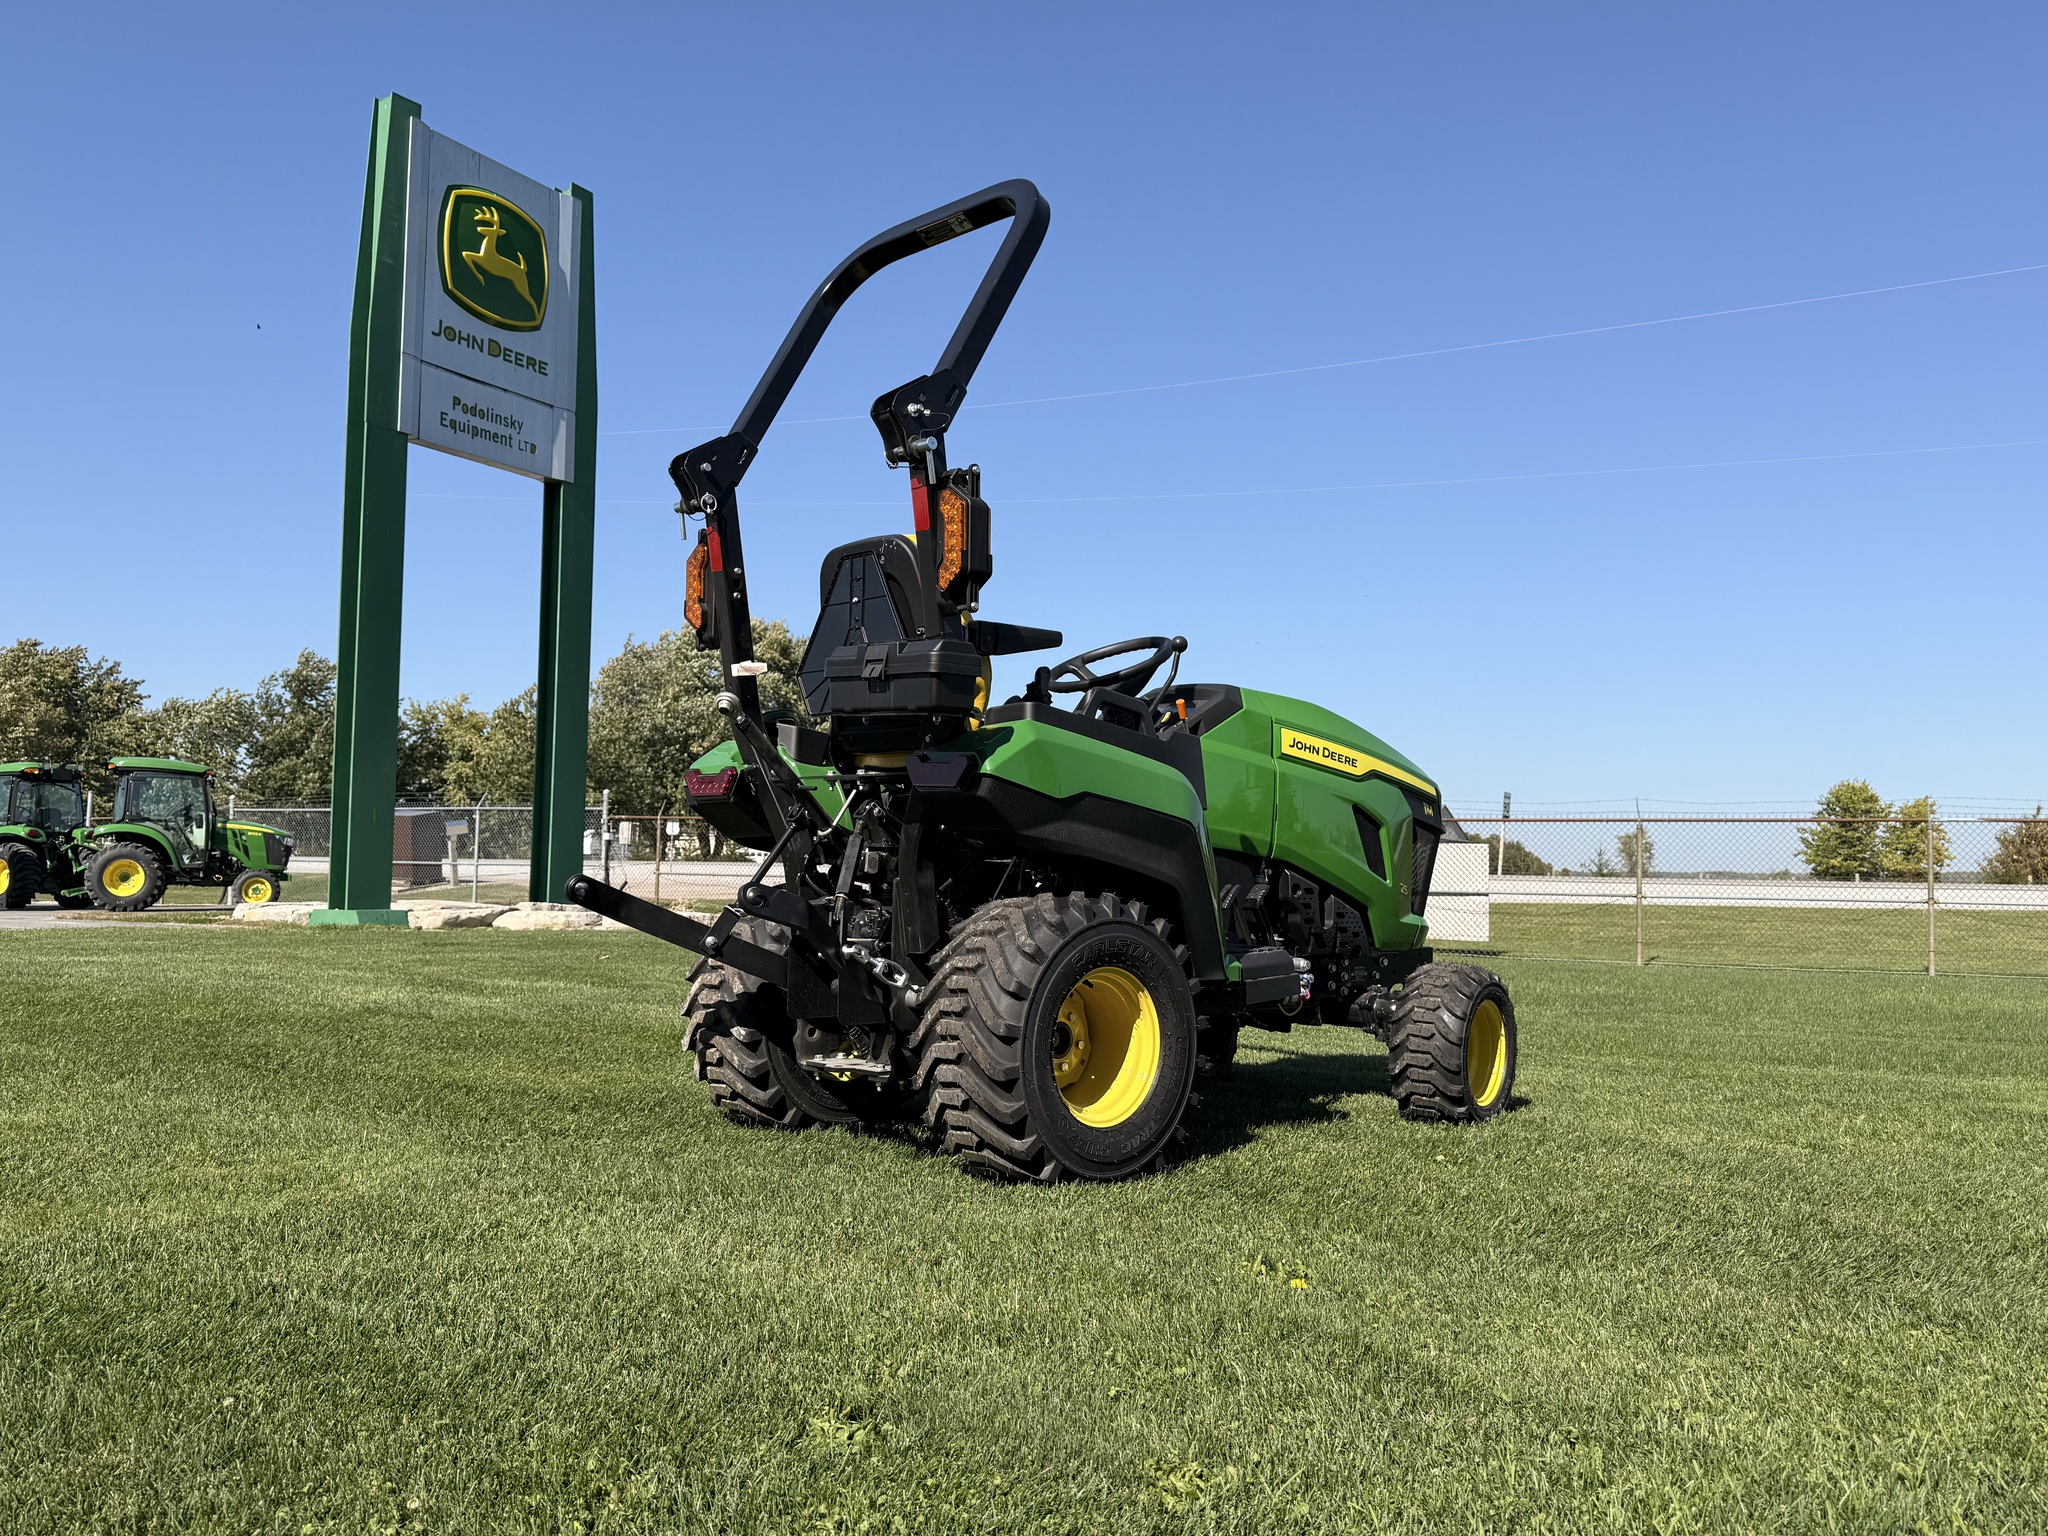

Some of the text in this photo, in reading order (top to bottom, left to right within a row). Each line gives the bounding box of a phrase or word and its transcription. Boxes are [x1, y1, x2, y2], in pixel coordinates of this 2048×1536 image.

[431, 319, 549, 377] JOHN DEERE
[440, 411, 537, 455] Equipment LTD
[452, 395, 524, 434] Podolinsky
[1288, 737, 1358, 768] JOHN DEERE
[1071, 938, 1158, 970] CARLSTAR
[1119, 1118, 1159, 1154] TRAC
